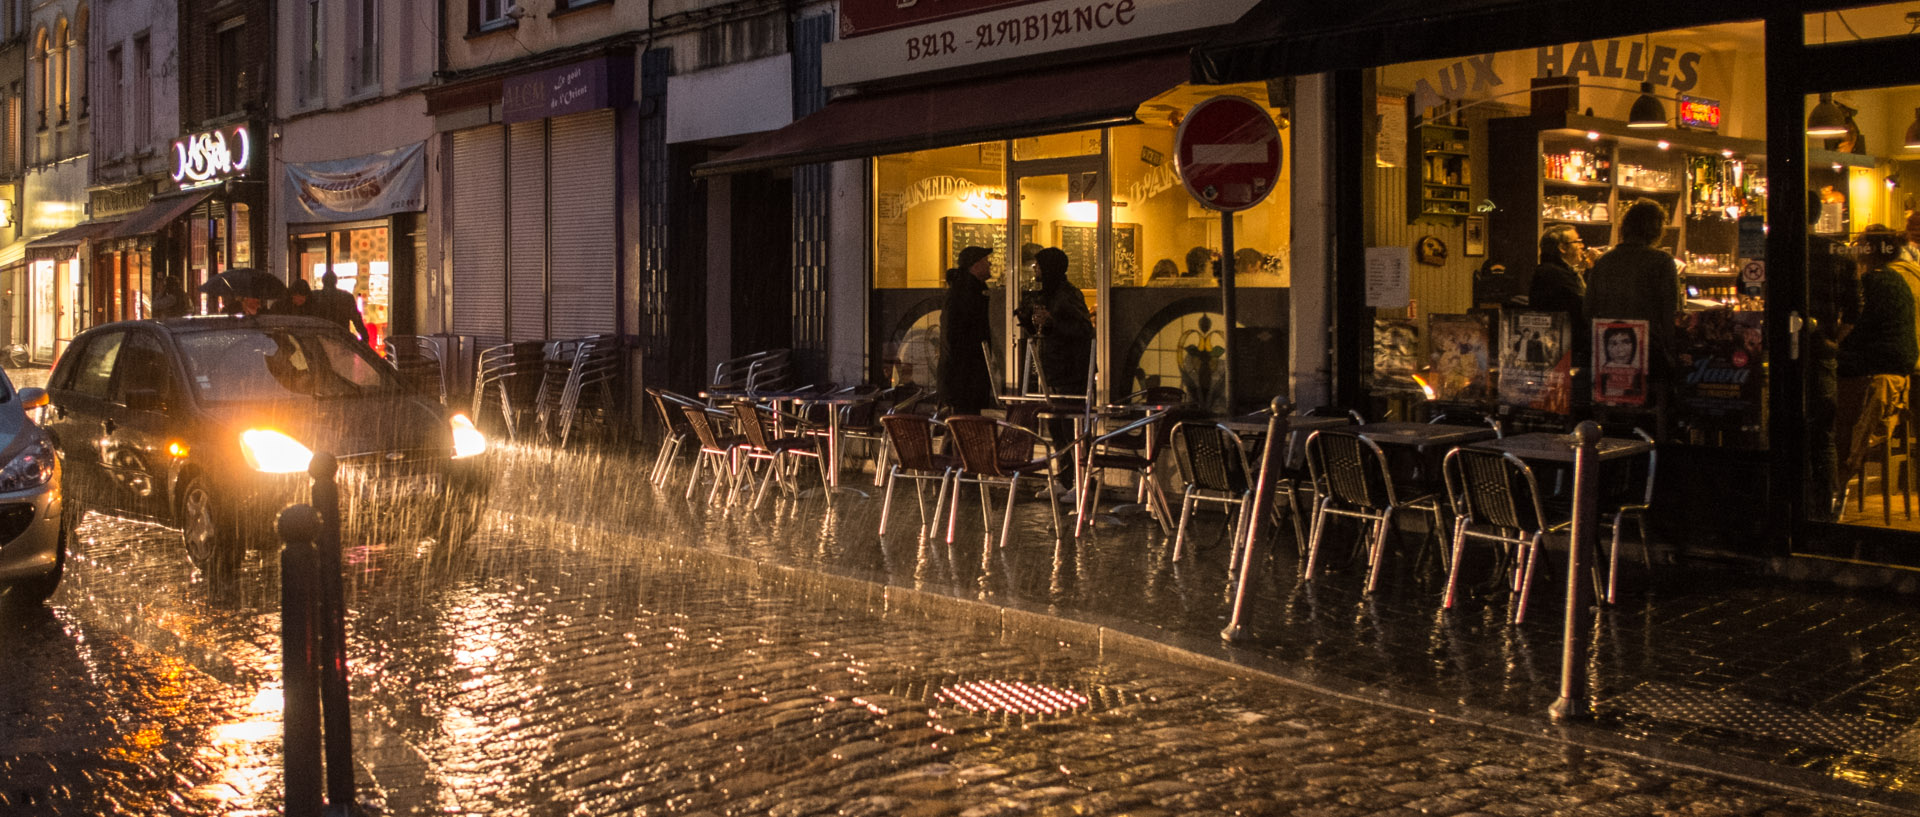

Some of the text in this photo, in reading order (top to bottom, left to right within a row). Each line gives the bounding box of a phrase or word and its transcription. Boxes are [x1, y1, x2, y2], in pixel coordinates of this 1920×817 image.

[906, 30, 957, 61] BAR
[554, 75, 566, 90] Le
[1414, 40, 1700, 117] AUX HALLES
[551, 84, 587, 108] de l'Orient
[1828, 241, 1894, 255] Fermé le
